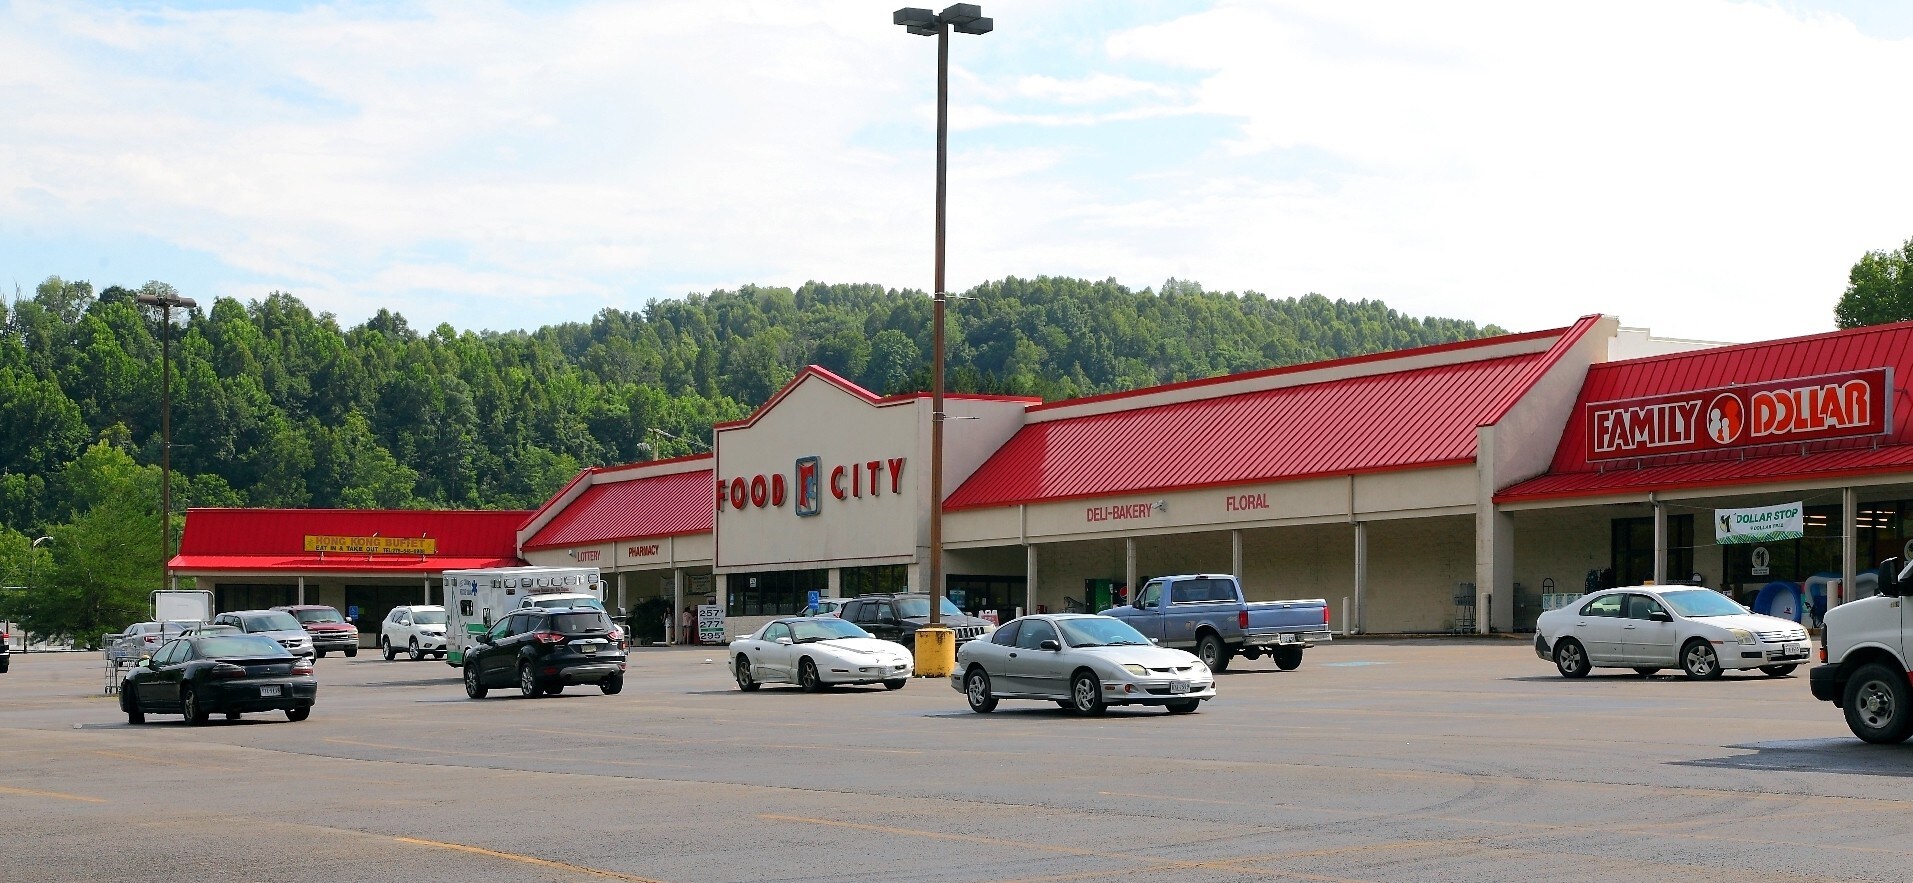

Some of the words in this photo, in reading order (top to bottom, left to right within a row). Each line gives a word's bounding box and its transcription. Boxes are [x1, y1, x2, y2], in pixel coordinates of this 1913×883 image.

[1594, 399, 1702, 452] FAMILY
[1751, 379, 1871, 438] DOLLAR
[716, 473, 788, 512] FOOD
[830, 456, 907, 500] CITY
[1226, 493, 1270, 512] FLORAL
[1086, 503, 1152, 522] DELI-BAKERY
[1736, 512, 1772, 524] DOLLAR
[1774, 508, 1798, 520] STOP
[315, 536, 346, 546] HONG
[350, 537, 381, 547] KONG
[385, 538, 425, 548] BUFFET
[628, 544, 660, 557] PHARMACY
[577, 550, 601, 562] LOTTERY
